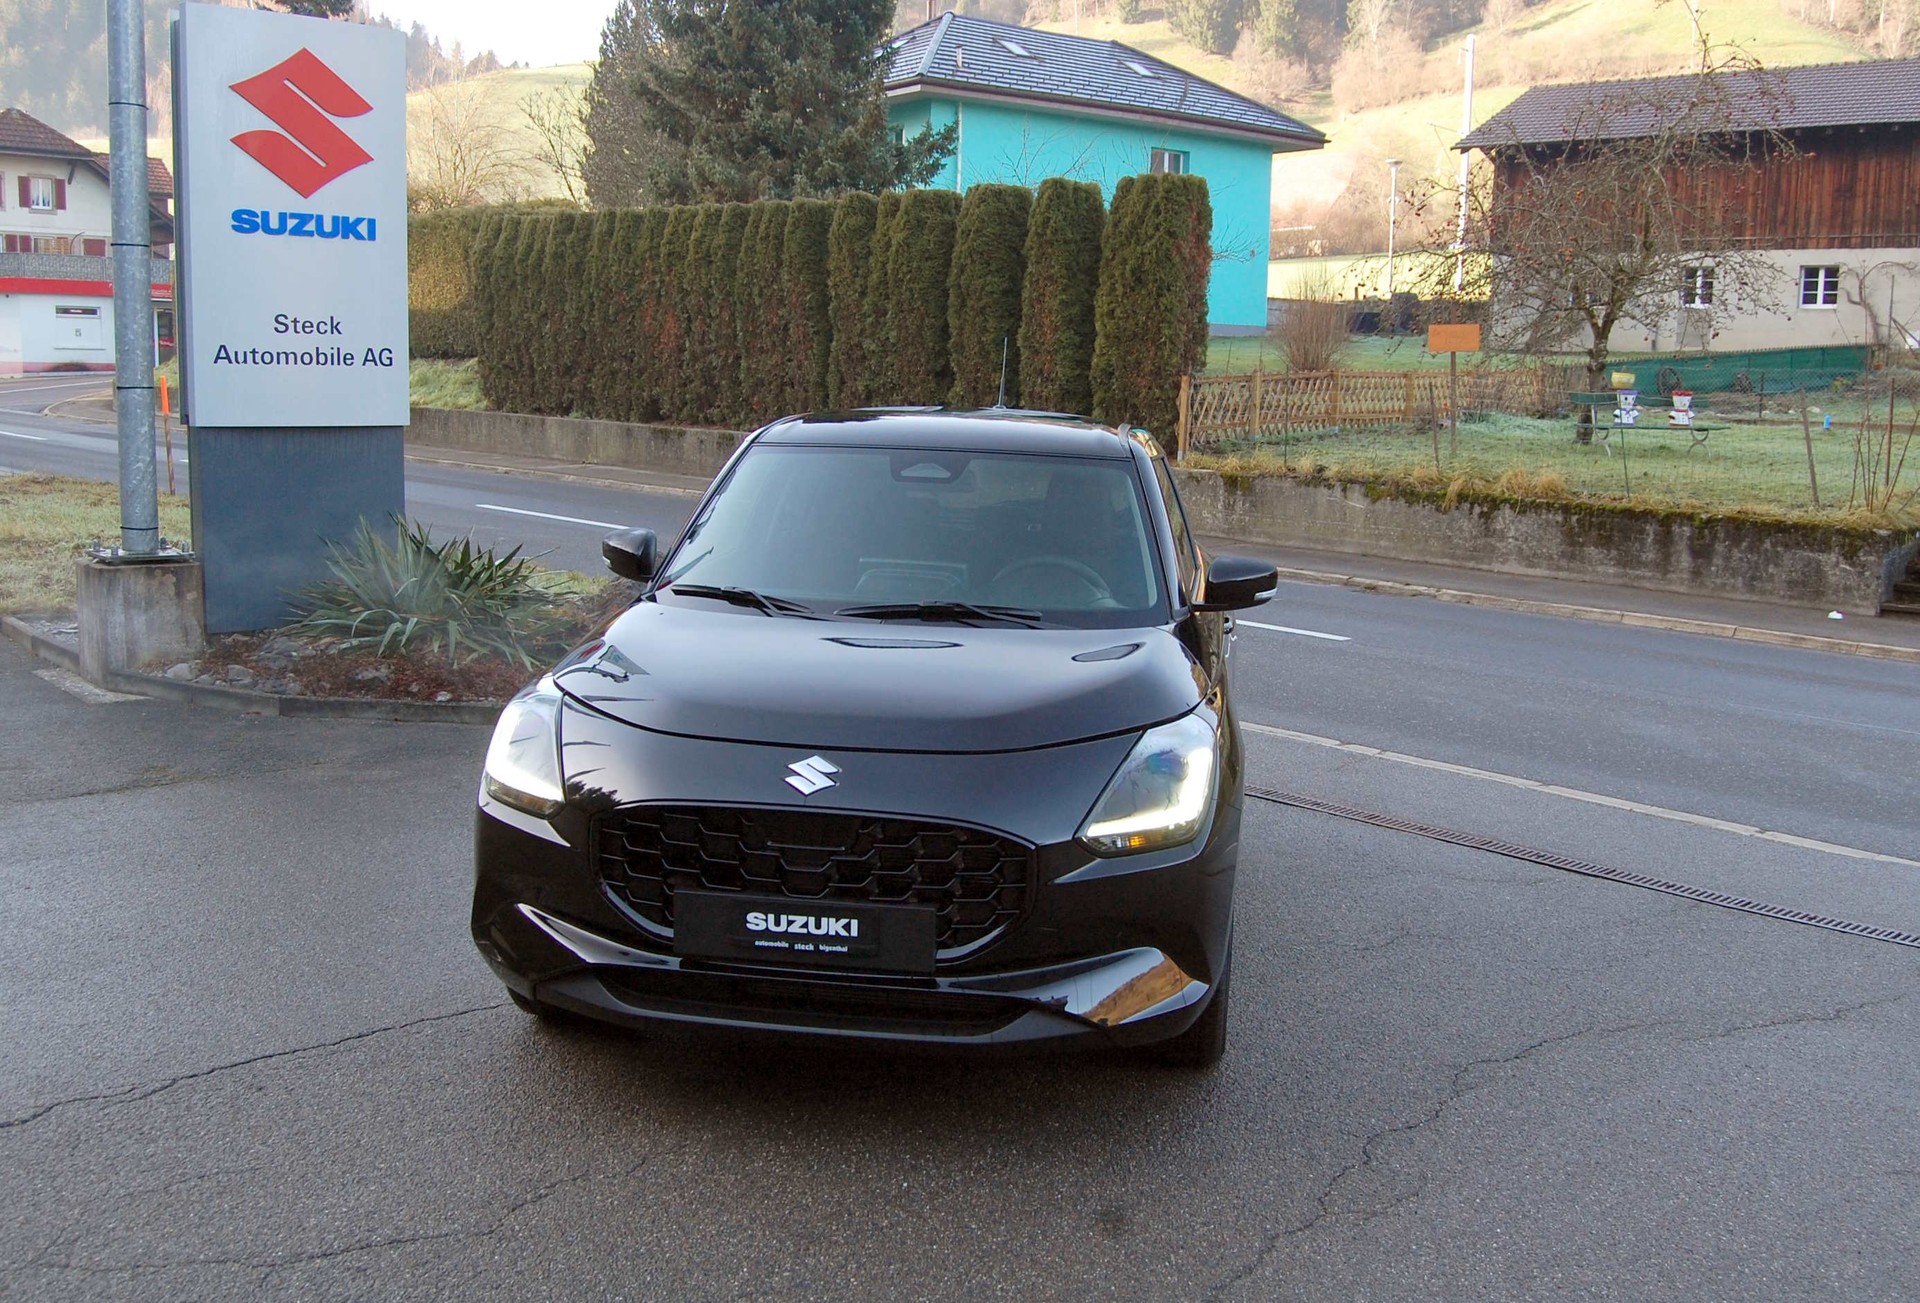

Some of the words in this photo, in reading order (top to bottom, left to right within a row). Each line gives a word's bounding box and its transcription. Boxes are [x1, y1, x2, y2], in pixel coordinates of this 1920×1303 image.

[230, 208, 377, 241] SUZUKI
[273, 313, 343, 335] Steck
[213, 344, 355, 366] Automobile
[362, 347, 393, 367] AG
[746, 912, 858, 937] SUZUKI
[754, 940, 789, 949] automobile
[794, 942, 815, 951] steck
